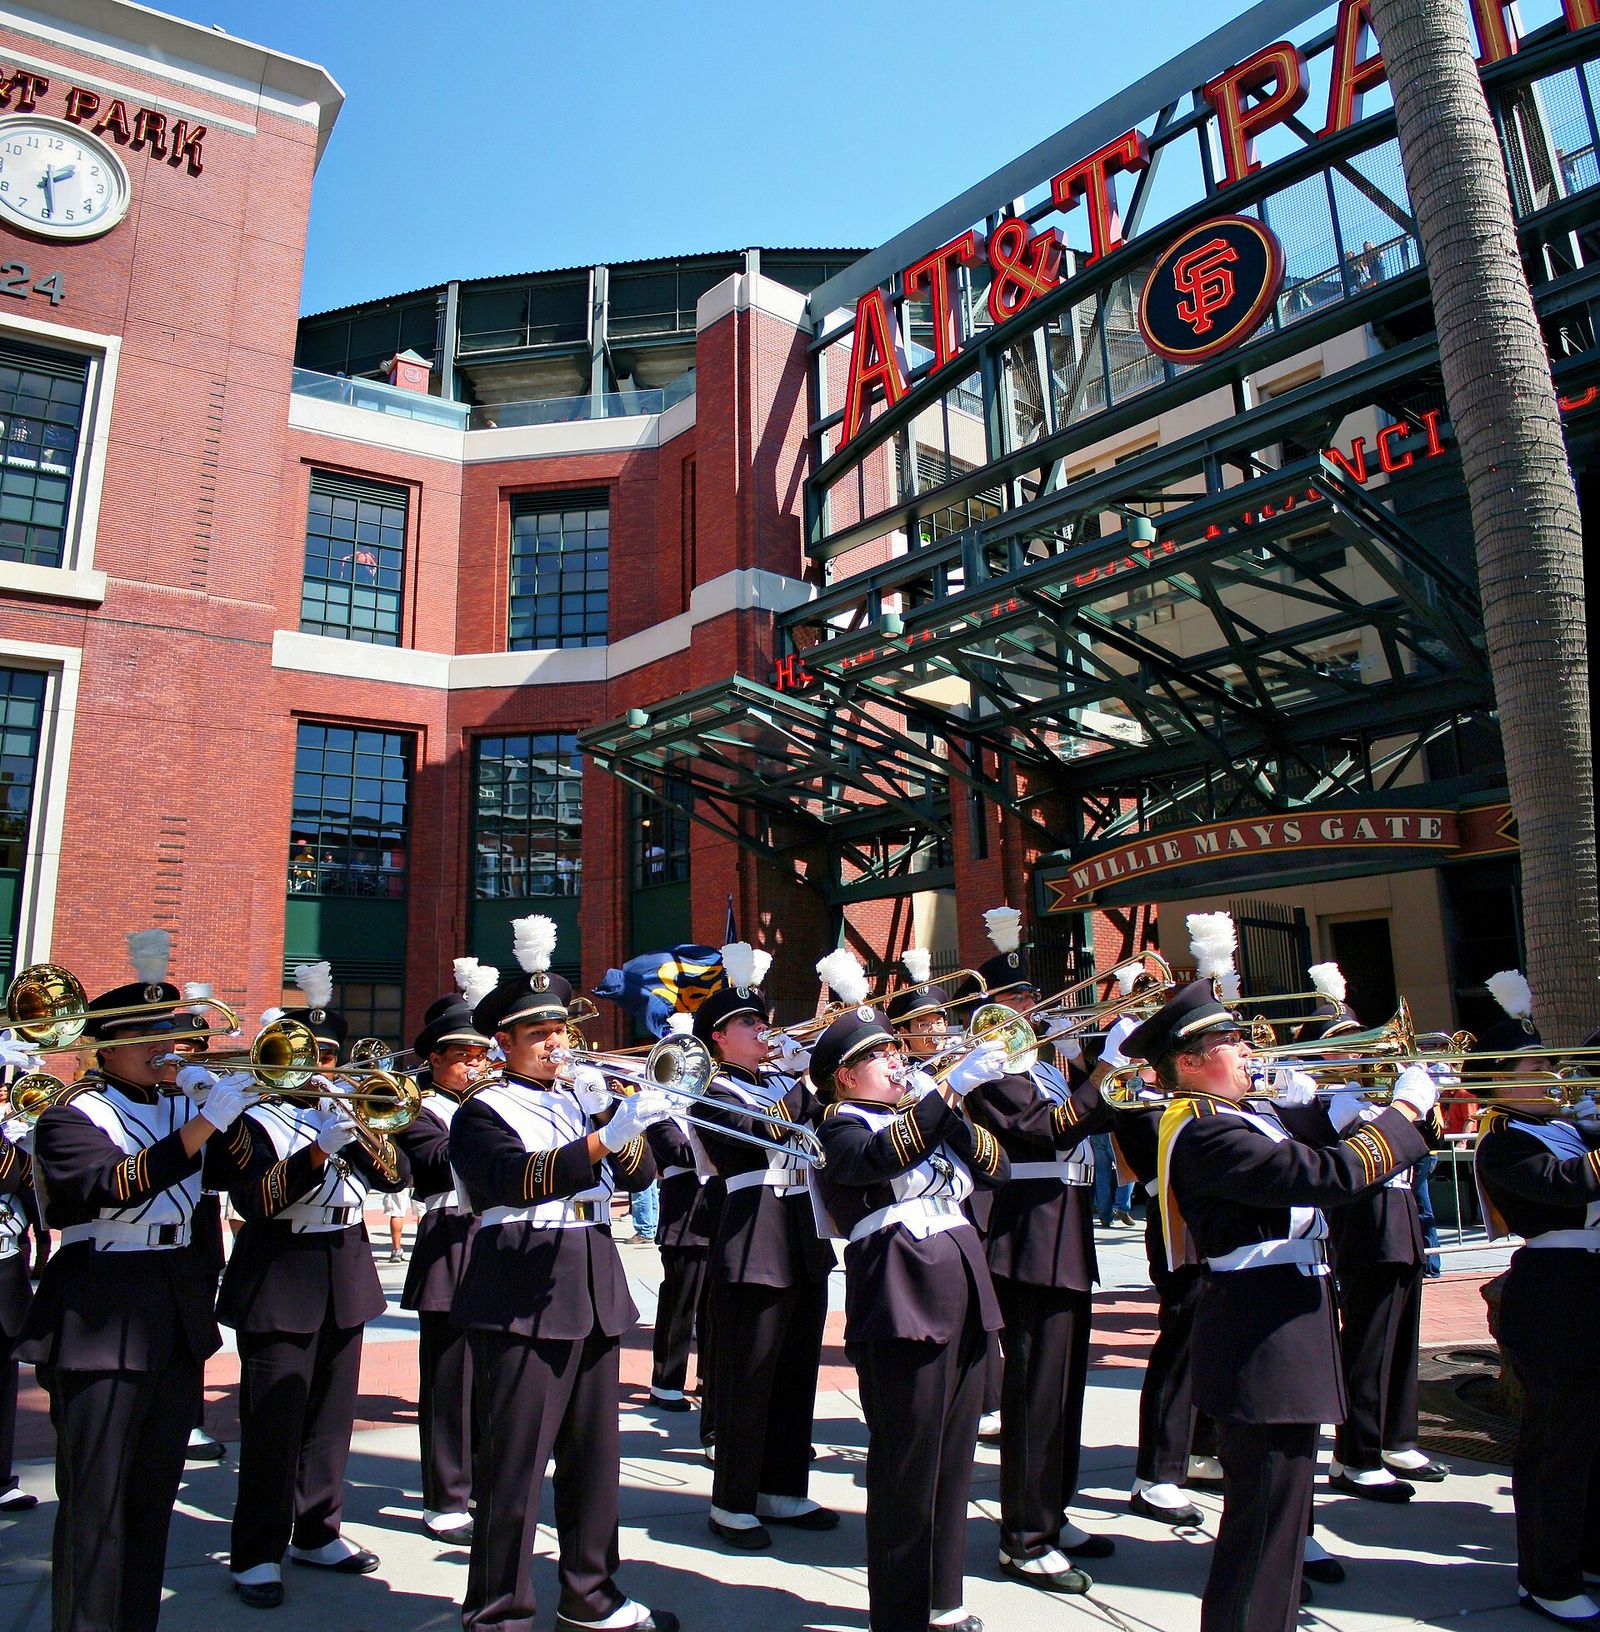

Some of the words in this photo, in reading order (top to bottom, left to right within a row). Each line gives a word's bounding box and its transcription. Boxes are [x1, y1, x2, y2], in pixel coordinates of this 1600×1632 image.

[65, 86, 208, 177] PARK
[5, 142, 23, 156] 10
[48, 138, 64, 151] 12
[90, 166, 100, 177] 2
[95, 183, 105, 195] 3
[18, 196, 28, 207] 7
[65, 209, 75, 221] 5
[0, 259, 65, 305] 24
[835, 128, 1147, 453] AT&T
[1072, 839, 1182, 889] WILLIE
[1193, 819, 1303, 855] MAYS
[1319, 816, 1443, 841] GATE
